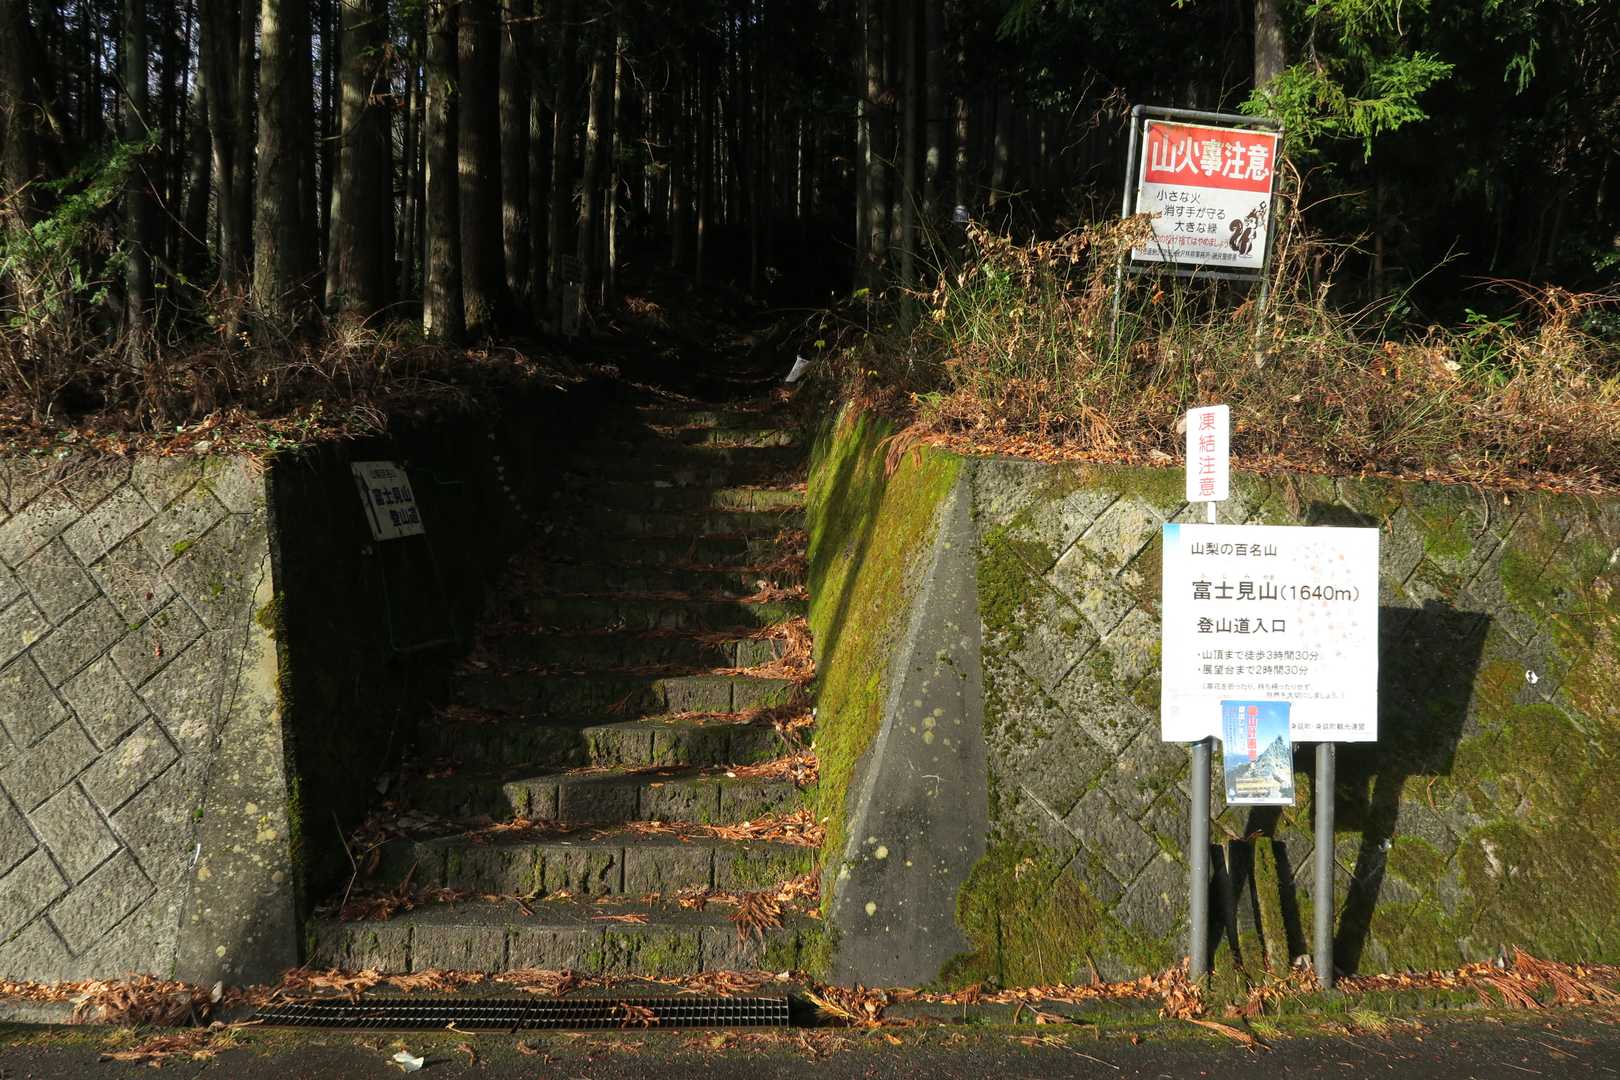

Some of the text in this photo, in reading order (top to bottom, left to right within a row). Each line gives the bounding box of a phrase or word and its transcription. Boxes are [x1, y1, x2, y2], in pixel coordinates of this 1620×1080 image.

[1151, 134, 1270, 182] 山火事注意
[1156, 189, 1201, 204] 小さな火
[1163, 204, 1227, 220] 消す手が守る
[1174, 220, 1218, 235] 大きな緑
[1198, 412, 1216, 497] 凍結注意
[371, 487, 413, 506] 富士見山
[1191, 541, 1278, 557] 山梨の百名山
[1192, 580, 1360, 602] 富士見山(1640m)
[1197, 617, 1286, 634] 登山道入口
